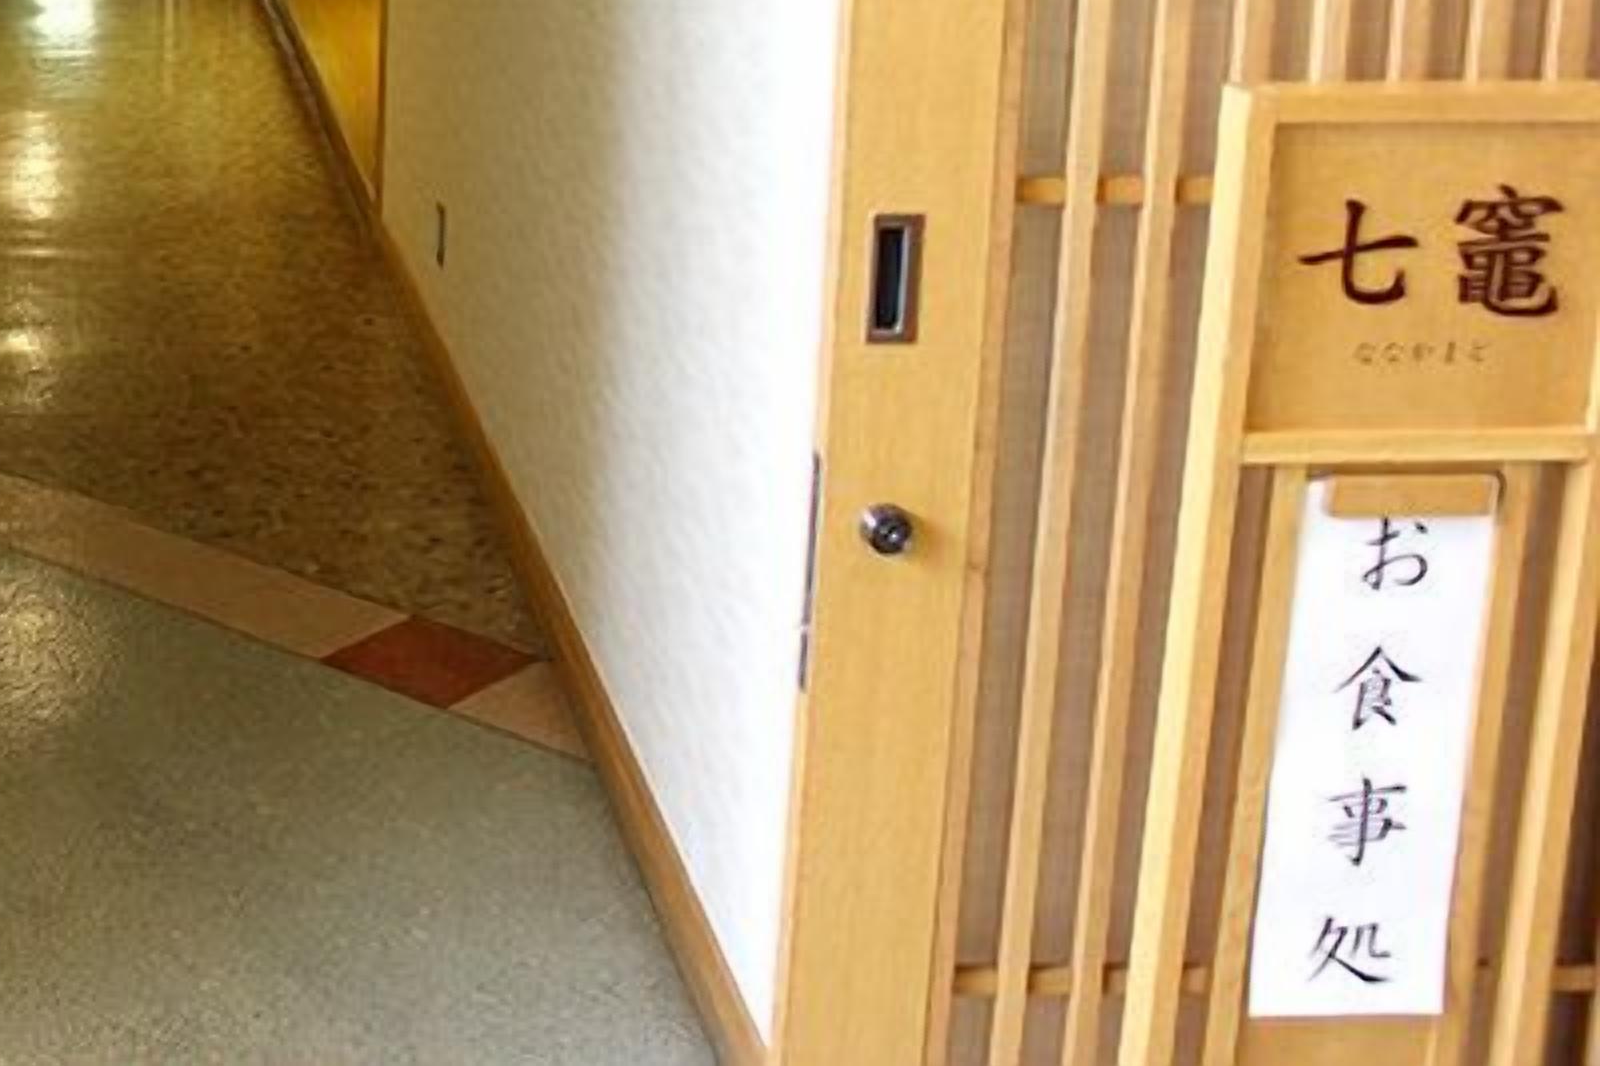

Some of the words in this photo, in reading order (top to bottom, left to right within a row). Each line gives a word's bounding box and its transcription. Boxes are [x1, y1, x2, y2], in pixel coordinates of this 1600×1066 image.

[1298, 184, 1565, 316] 七竈
[1307, 517, 1429, 983] お食事処
